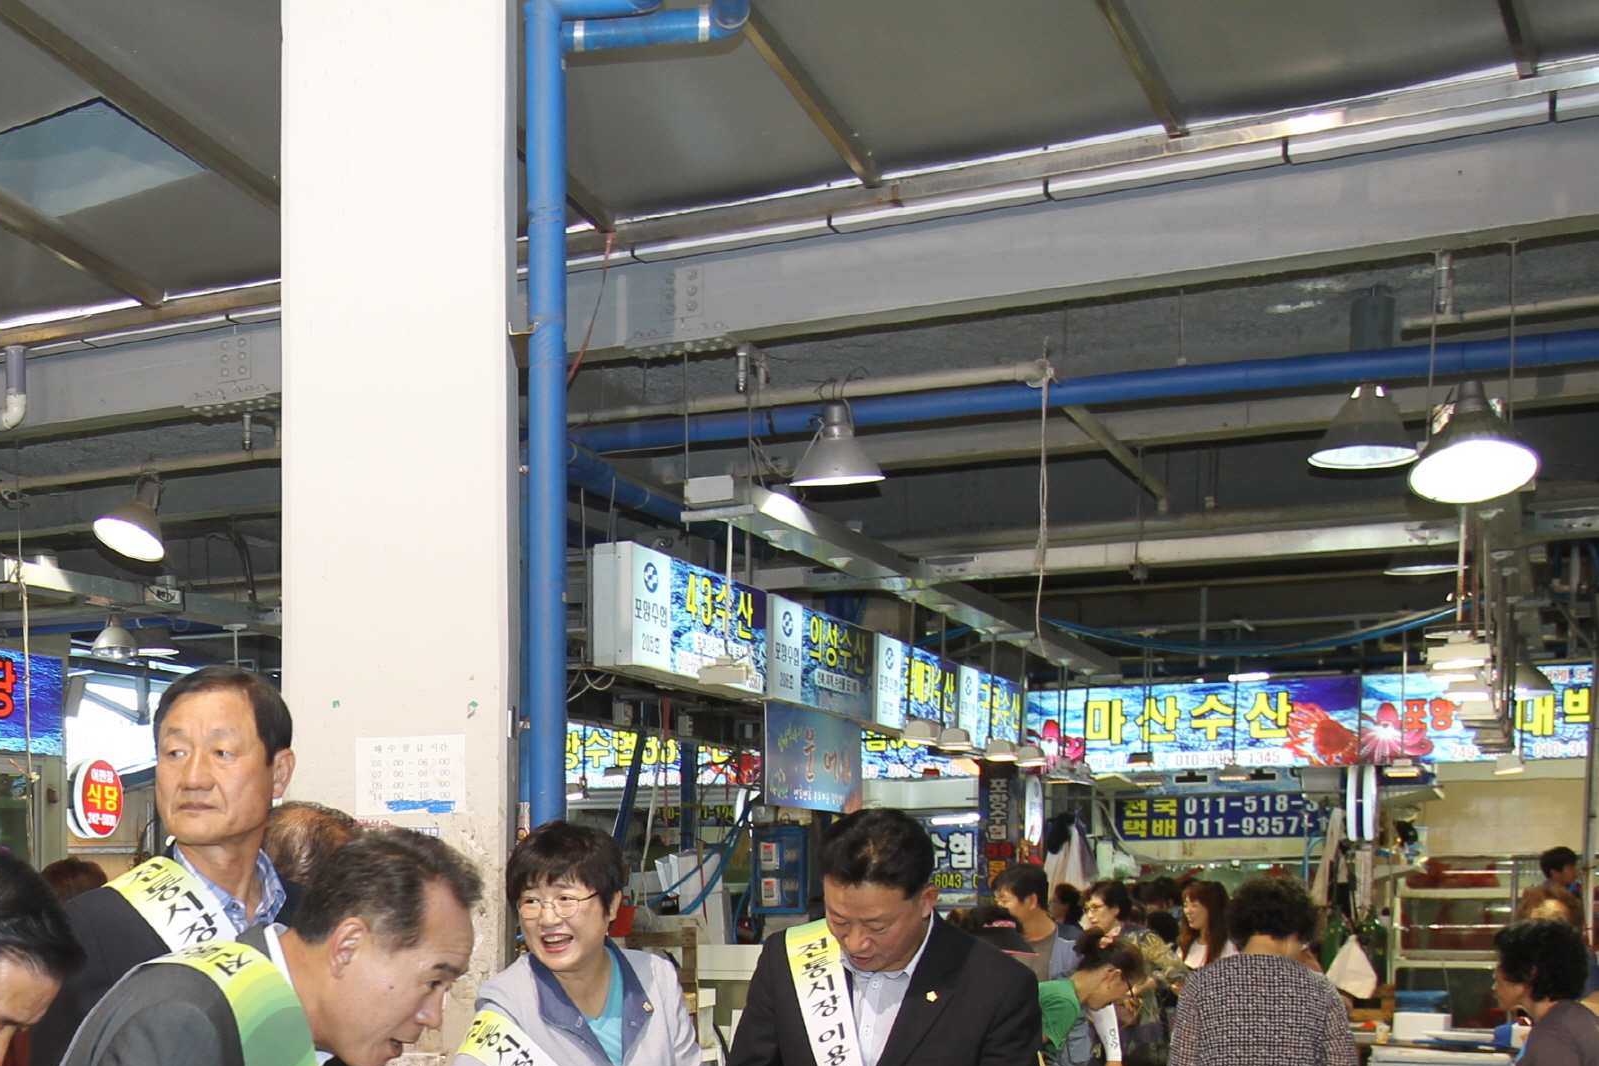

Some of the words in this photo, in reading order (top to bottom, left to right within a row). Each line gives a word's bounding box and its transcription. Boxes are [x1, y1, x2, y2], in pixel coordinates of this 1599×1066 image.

[641, 632, 661, 655] 205호
[809, 615, 866, 675] 의성수산
[1085, 691, 1294, 746] 마산수산
[1405, 697, 1463, 730] 포항
[91, 768, 114, 783] 어판장
[87, 784, 119, 811] 식당
[988, 778, 1008, 841] 포항수협
[1123, 798, 1179, 817] 전국
[1122, 818, 1178, 838] 택배
[125, 863, 218, 945] 전통시장
[799, 937, 842, 1018] 전통시장
